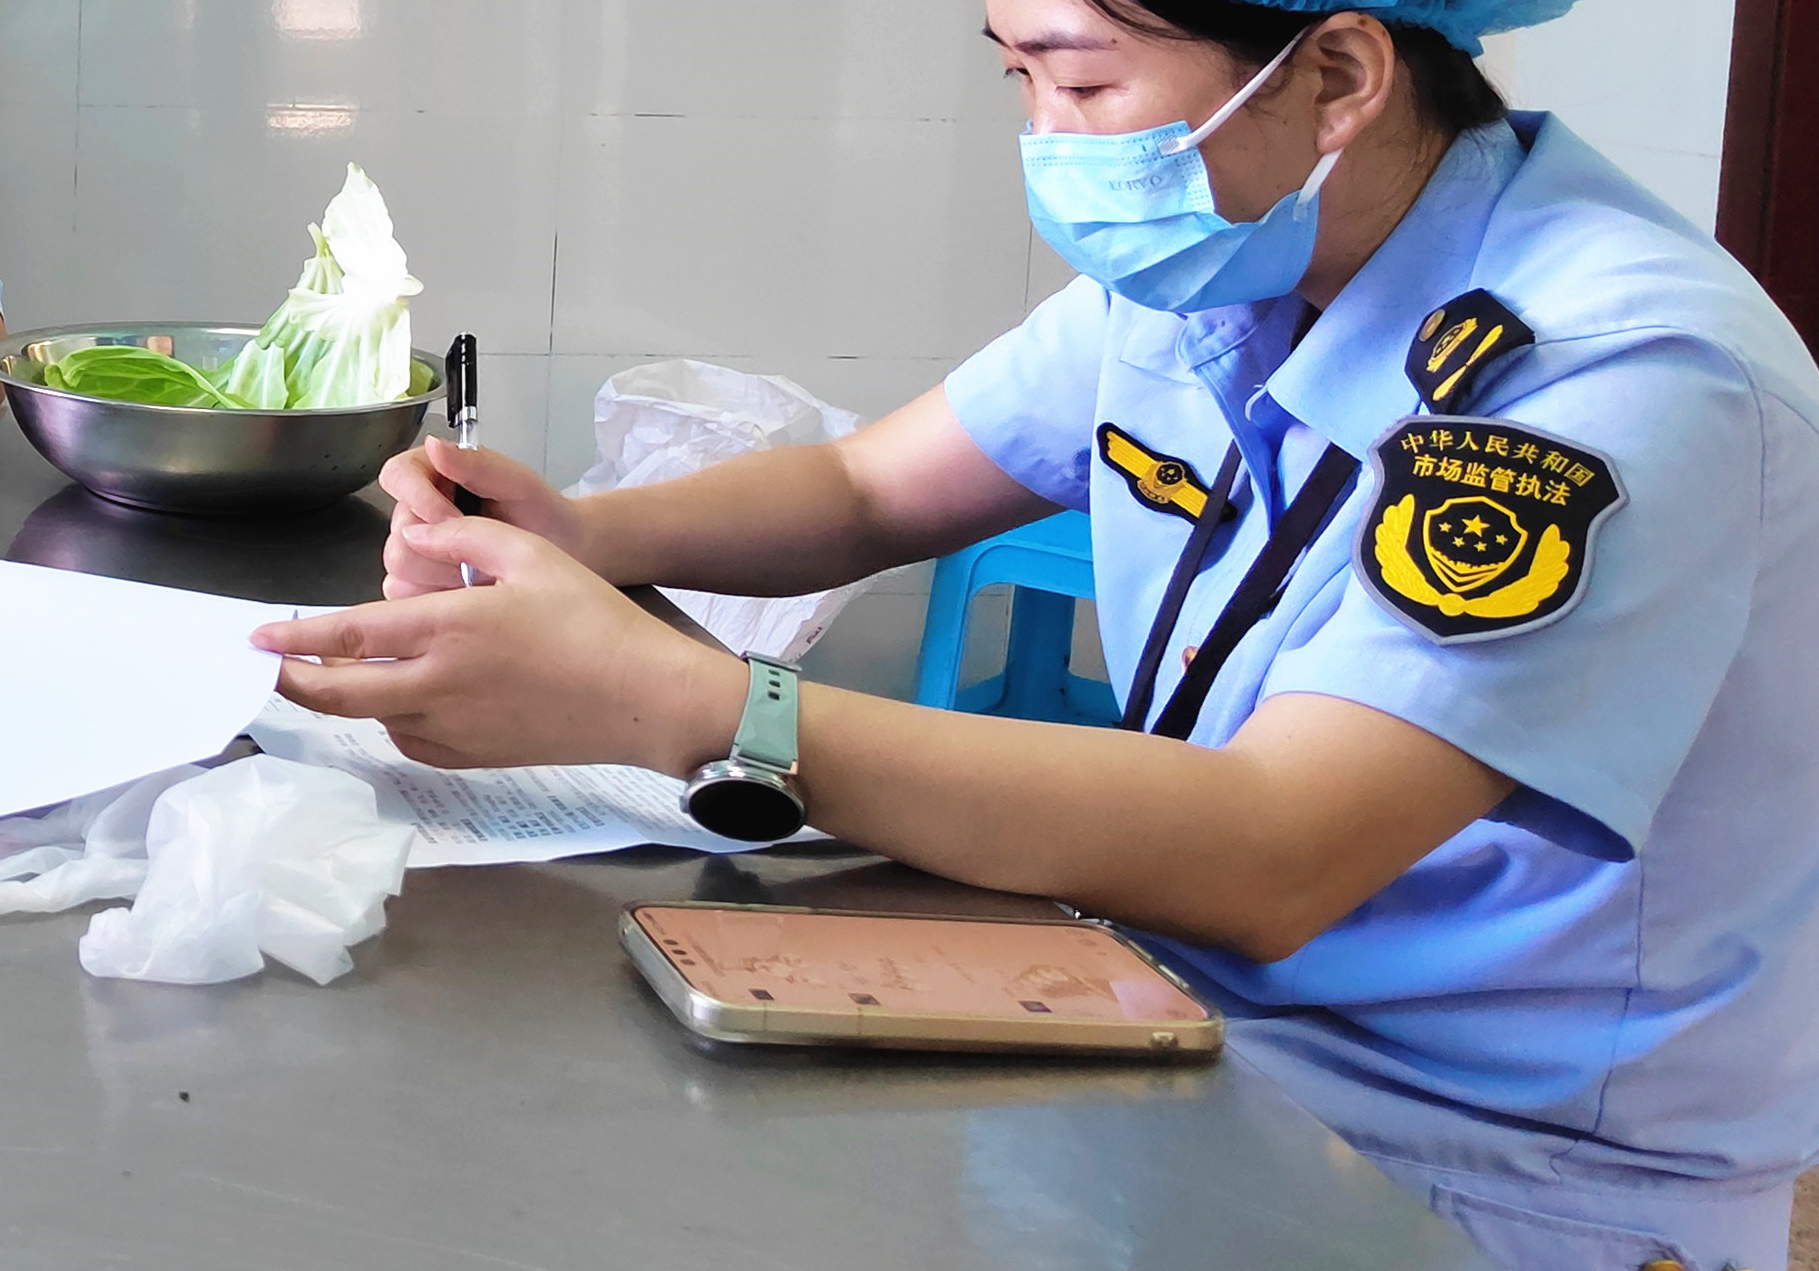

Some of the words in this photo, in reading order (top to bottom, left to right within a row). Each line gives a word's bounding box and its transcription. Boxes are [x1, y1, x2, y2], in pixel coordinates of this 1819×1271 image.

[1400, 429, 1596, 487] 中华人民共和国
[1412, 453, 1571, 505] 市场监管执法
